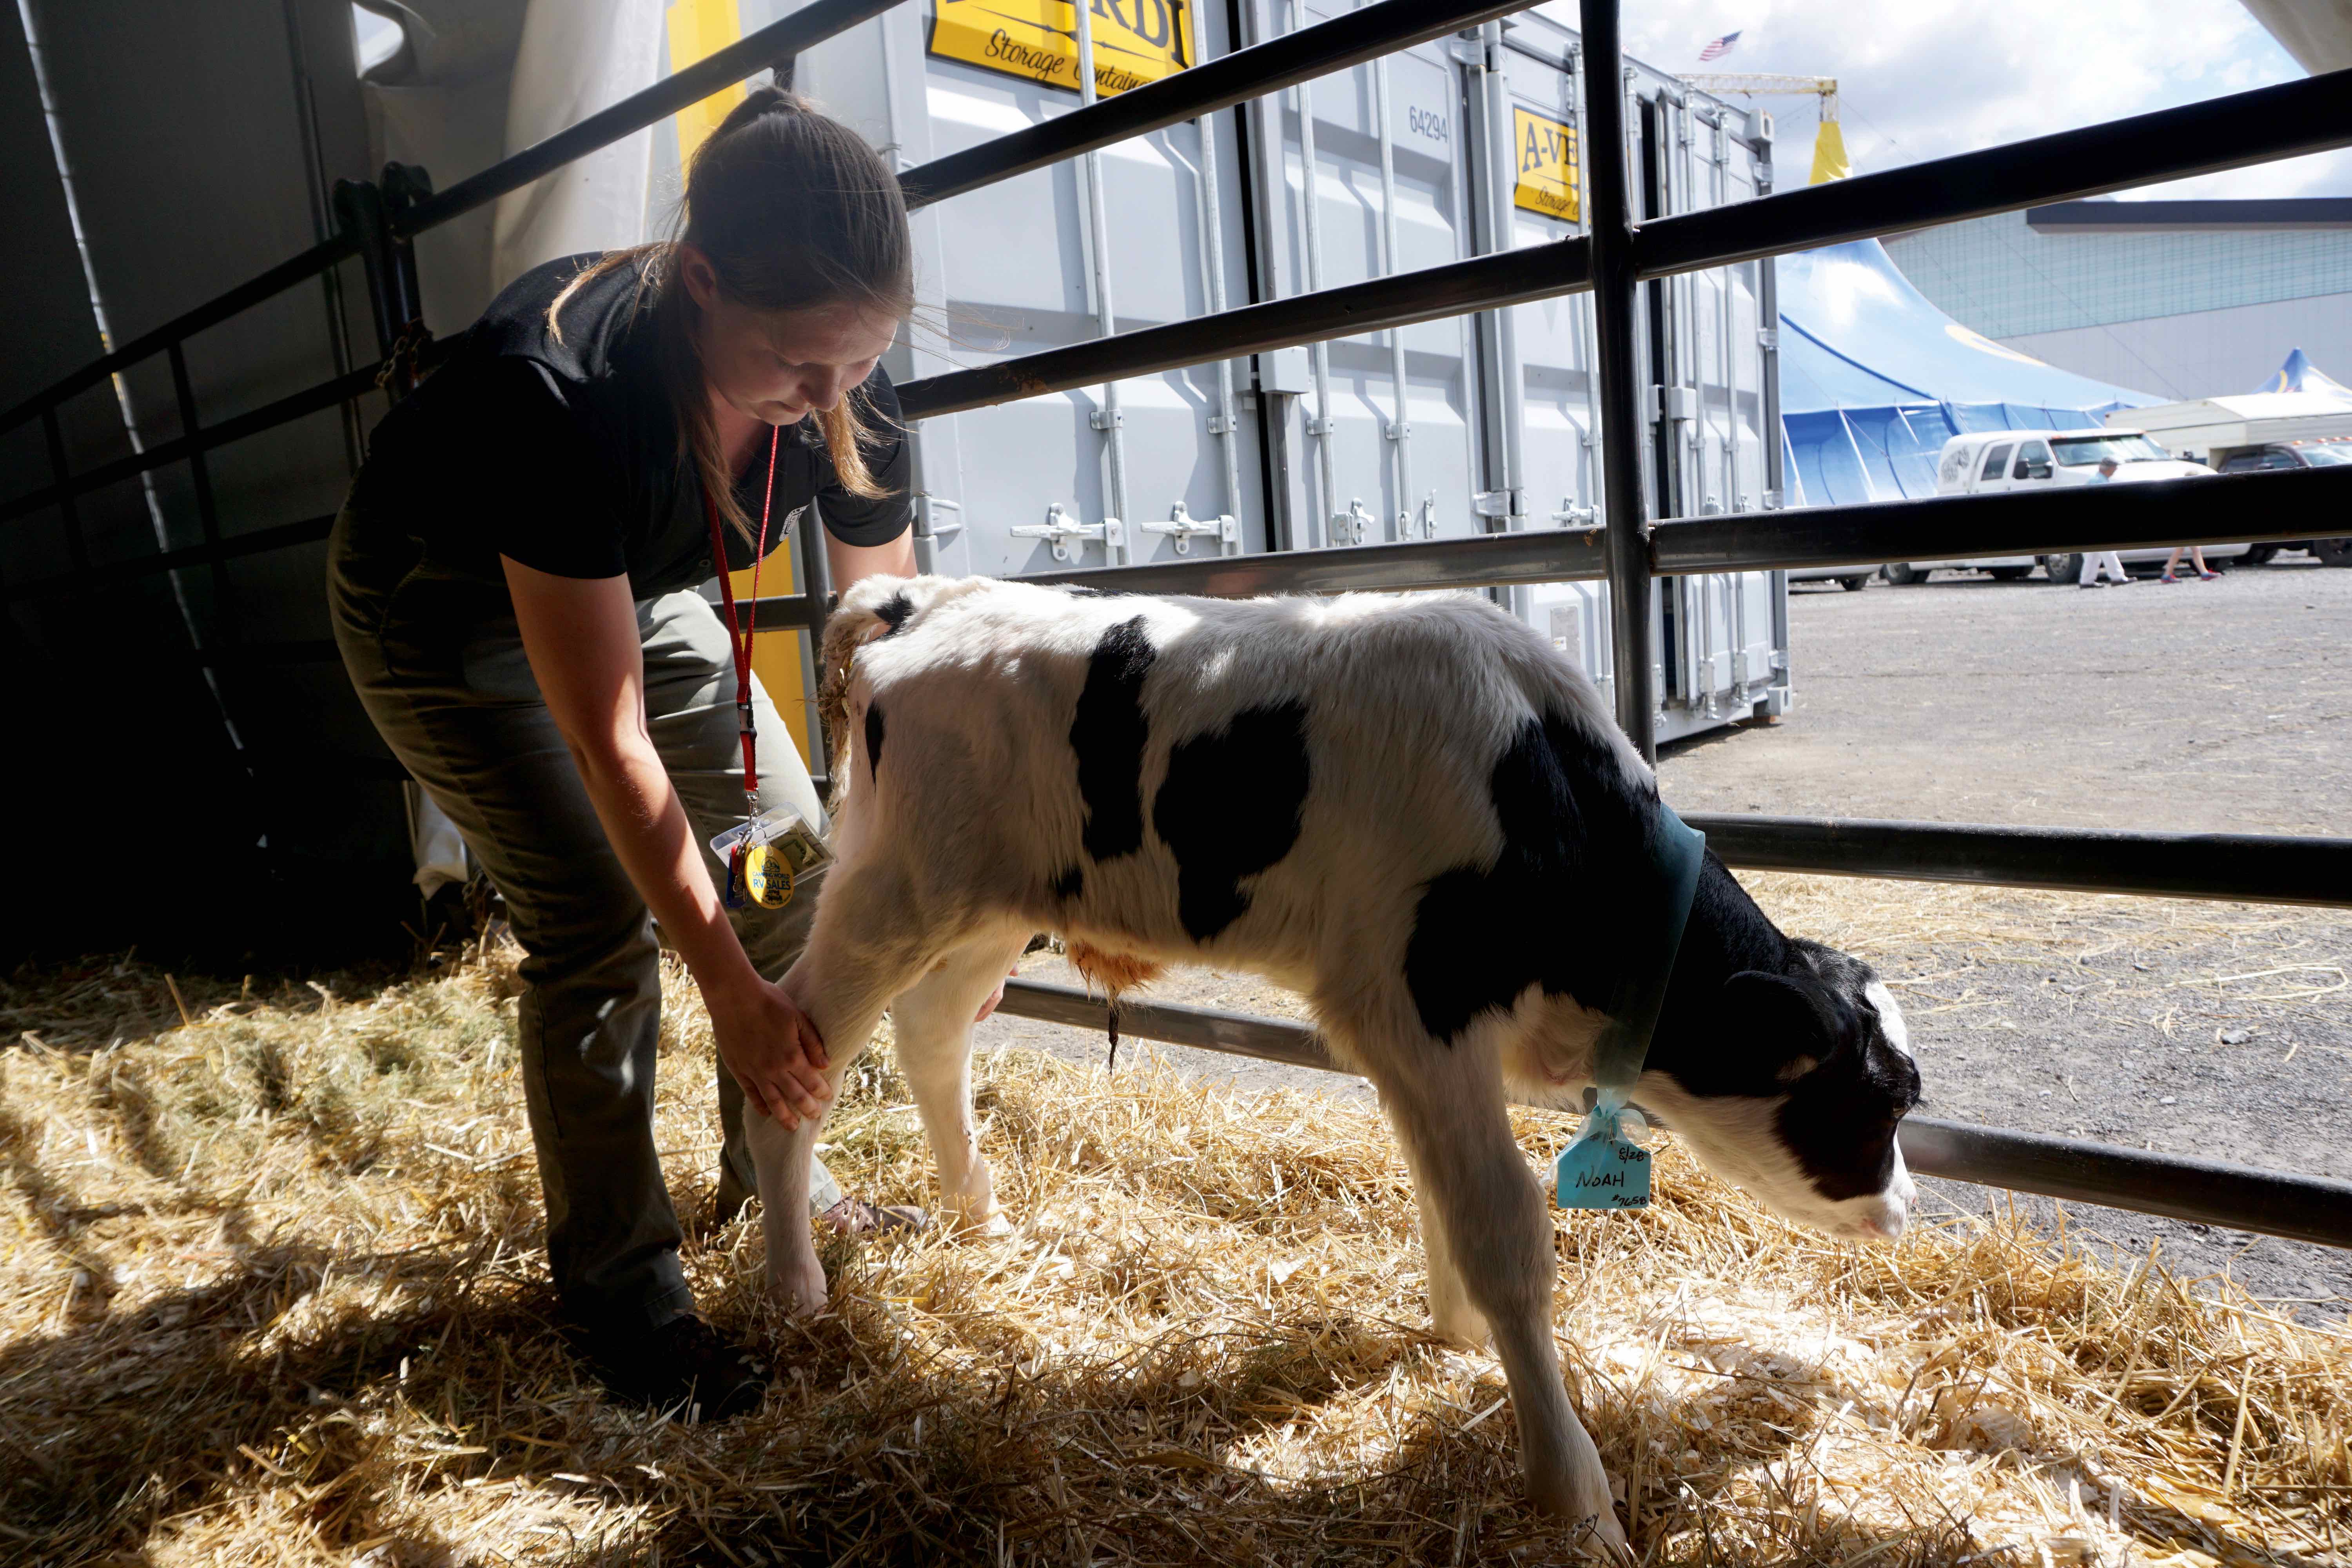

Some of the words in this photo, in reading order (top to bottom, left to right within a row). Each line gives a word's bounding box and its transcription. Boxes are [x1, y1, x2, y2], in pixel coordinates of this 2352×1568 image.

[985, 28, 1065, 80] Storage
[1073, 64, 1152, 92] Cntain
[1410, 105, 1448, 143] 64294
[1522, 121, 1578, 173] A-VE
[1535, 186, 1571, 214] Storage
[753, 878, 764, 888] RV
[766, 879, 791, 889] SALES
[1619, 1146, 1644, 1164] 8/28
[1575, 1165, 1624, 1188] NOAH
[1610, 1194, 1647, 1207] #7658
